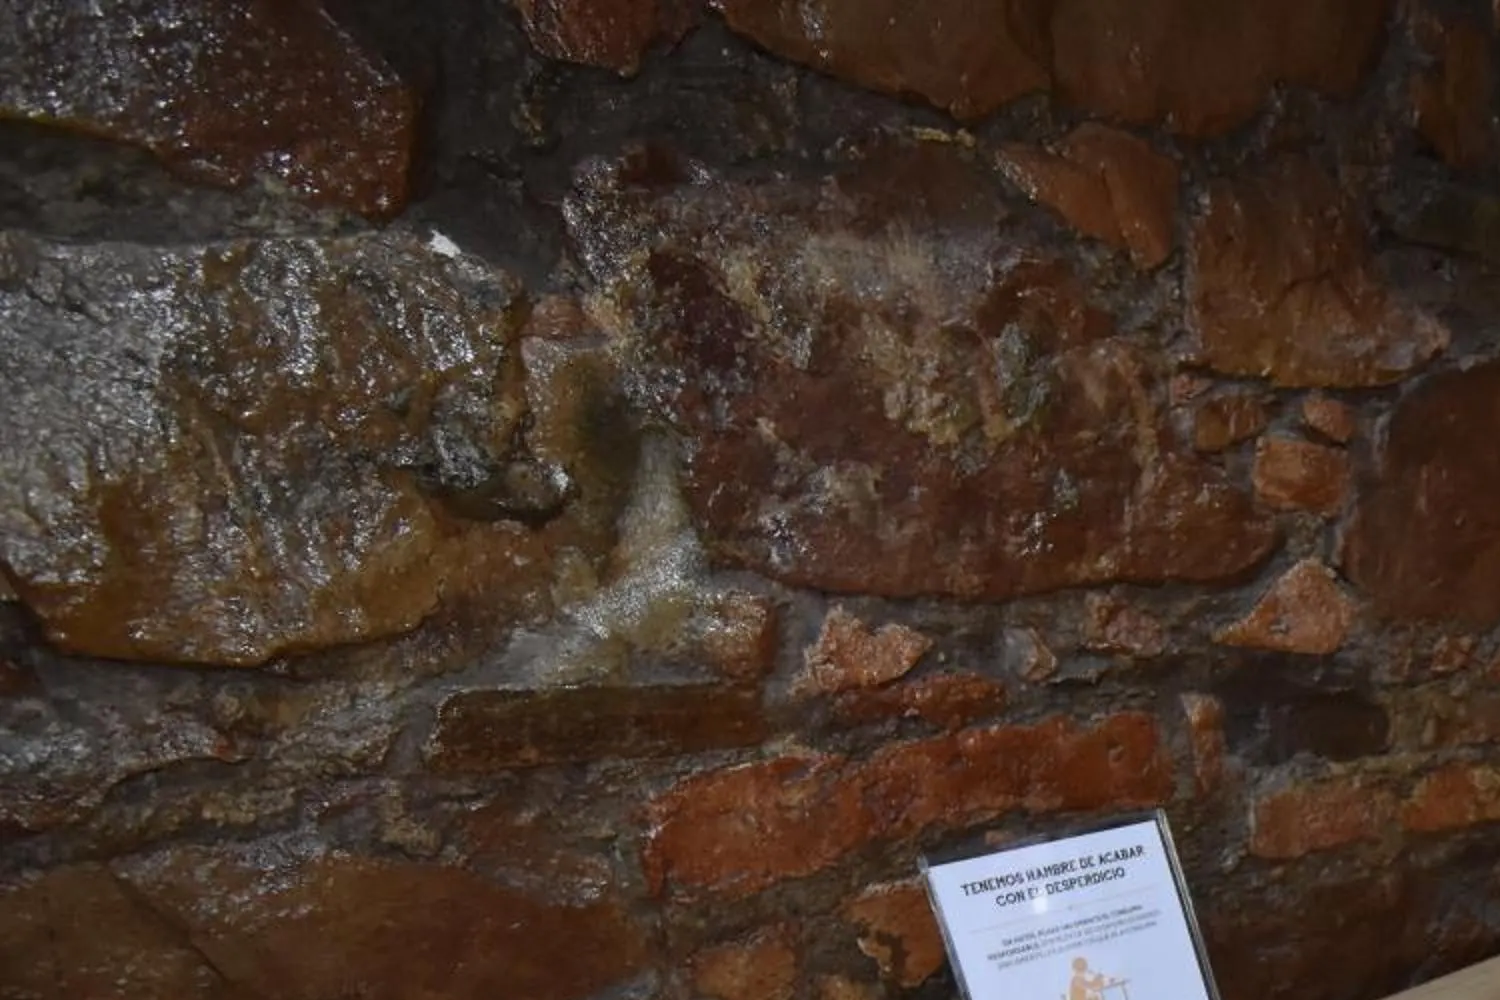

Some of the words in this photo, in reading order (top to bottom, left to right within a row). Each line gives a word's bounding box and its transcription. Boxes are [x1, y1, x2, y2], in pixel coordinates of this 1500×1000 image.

[960, 872, 1025, 897] TENEMOS
[1026, 861, 1077, 882] HAMBRE
[1079, 857, 1096, 869] DE
[1099, 845, 1145, 866] ACABAR
[996, 891, 1026, 907] CON
[1046, 867, 1126, 896] DESPERDICIO
